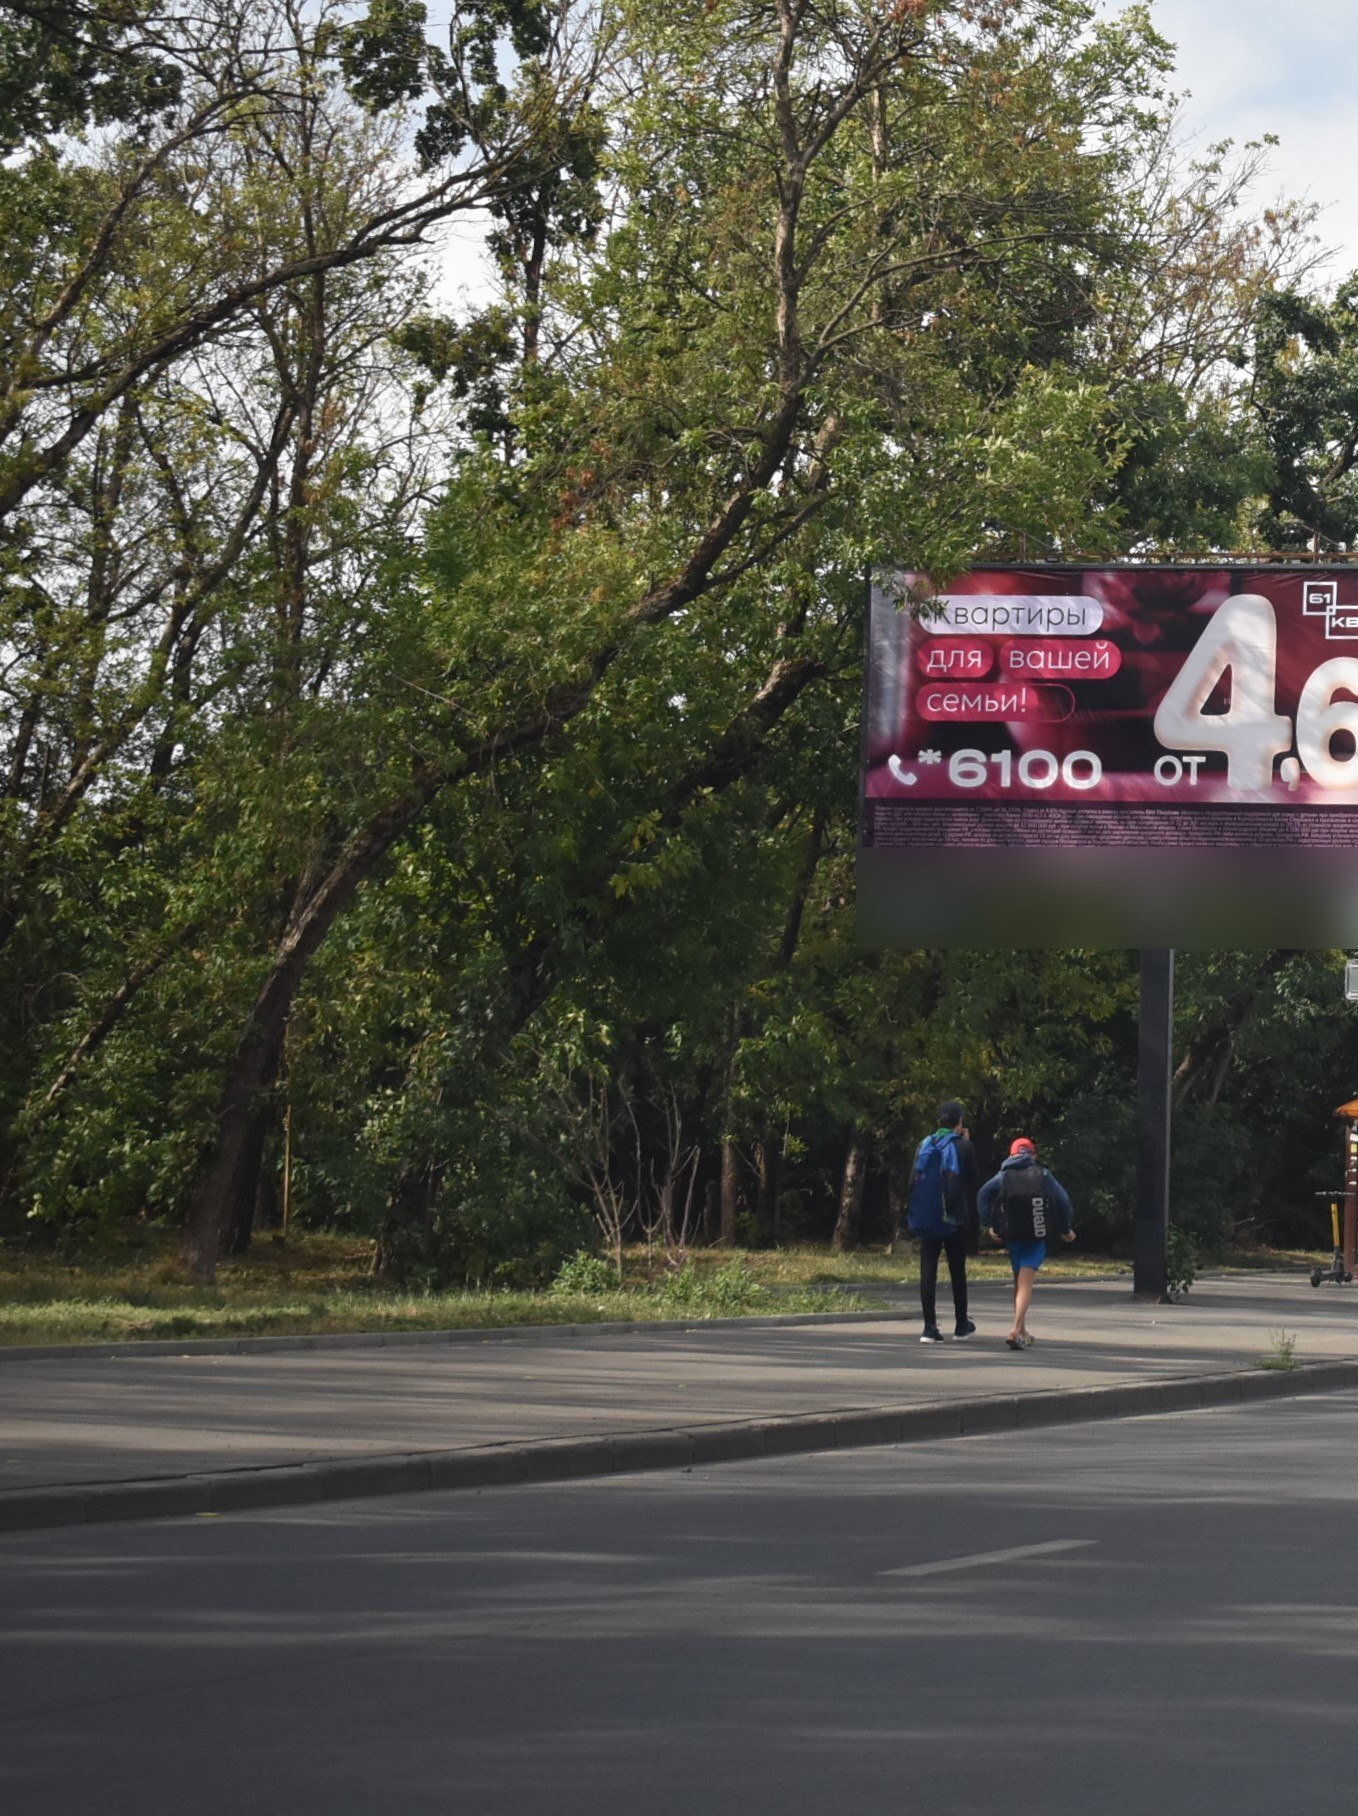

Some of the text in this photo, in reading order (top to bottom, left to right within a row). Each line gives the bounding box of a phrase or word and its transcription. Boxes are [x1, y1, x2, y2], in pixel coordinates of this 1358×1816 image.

[1308, 593, 1331, 604] 61
[926, 642, 1110, 673] для вашей
[927, 687, 1026, 712] семьи!
[1032, 1197, 1046, 1237] arena
